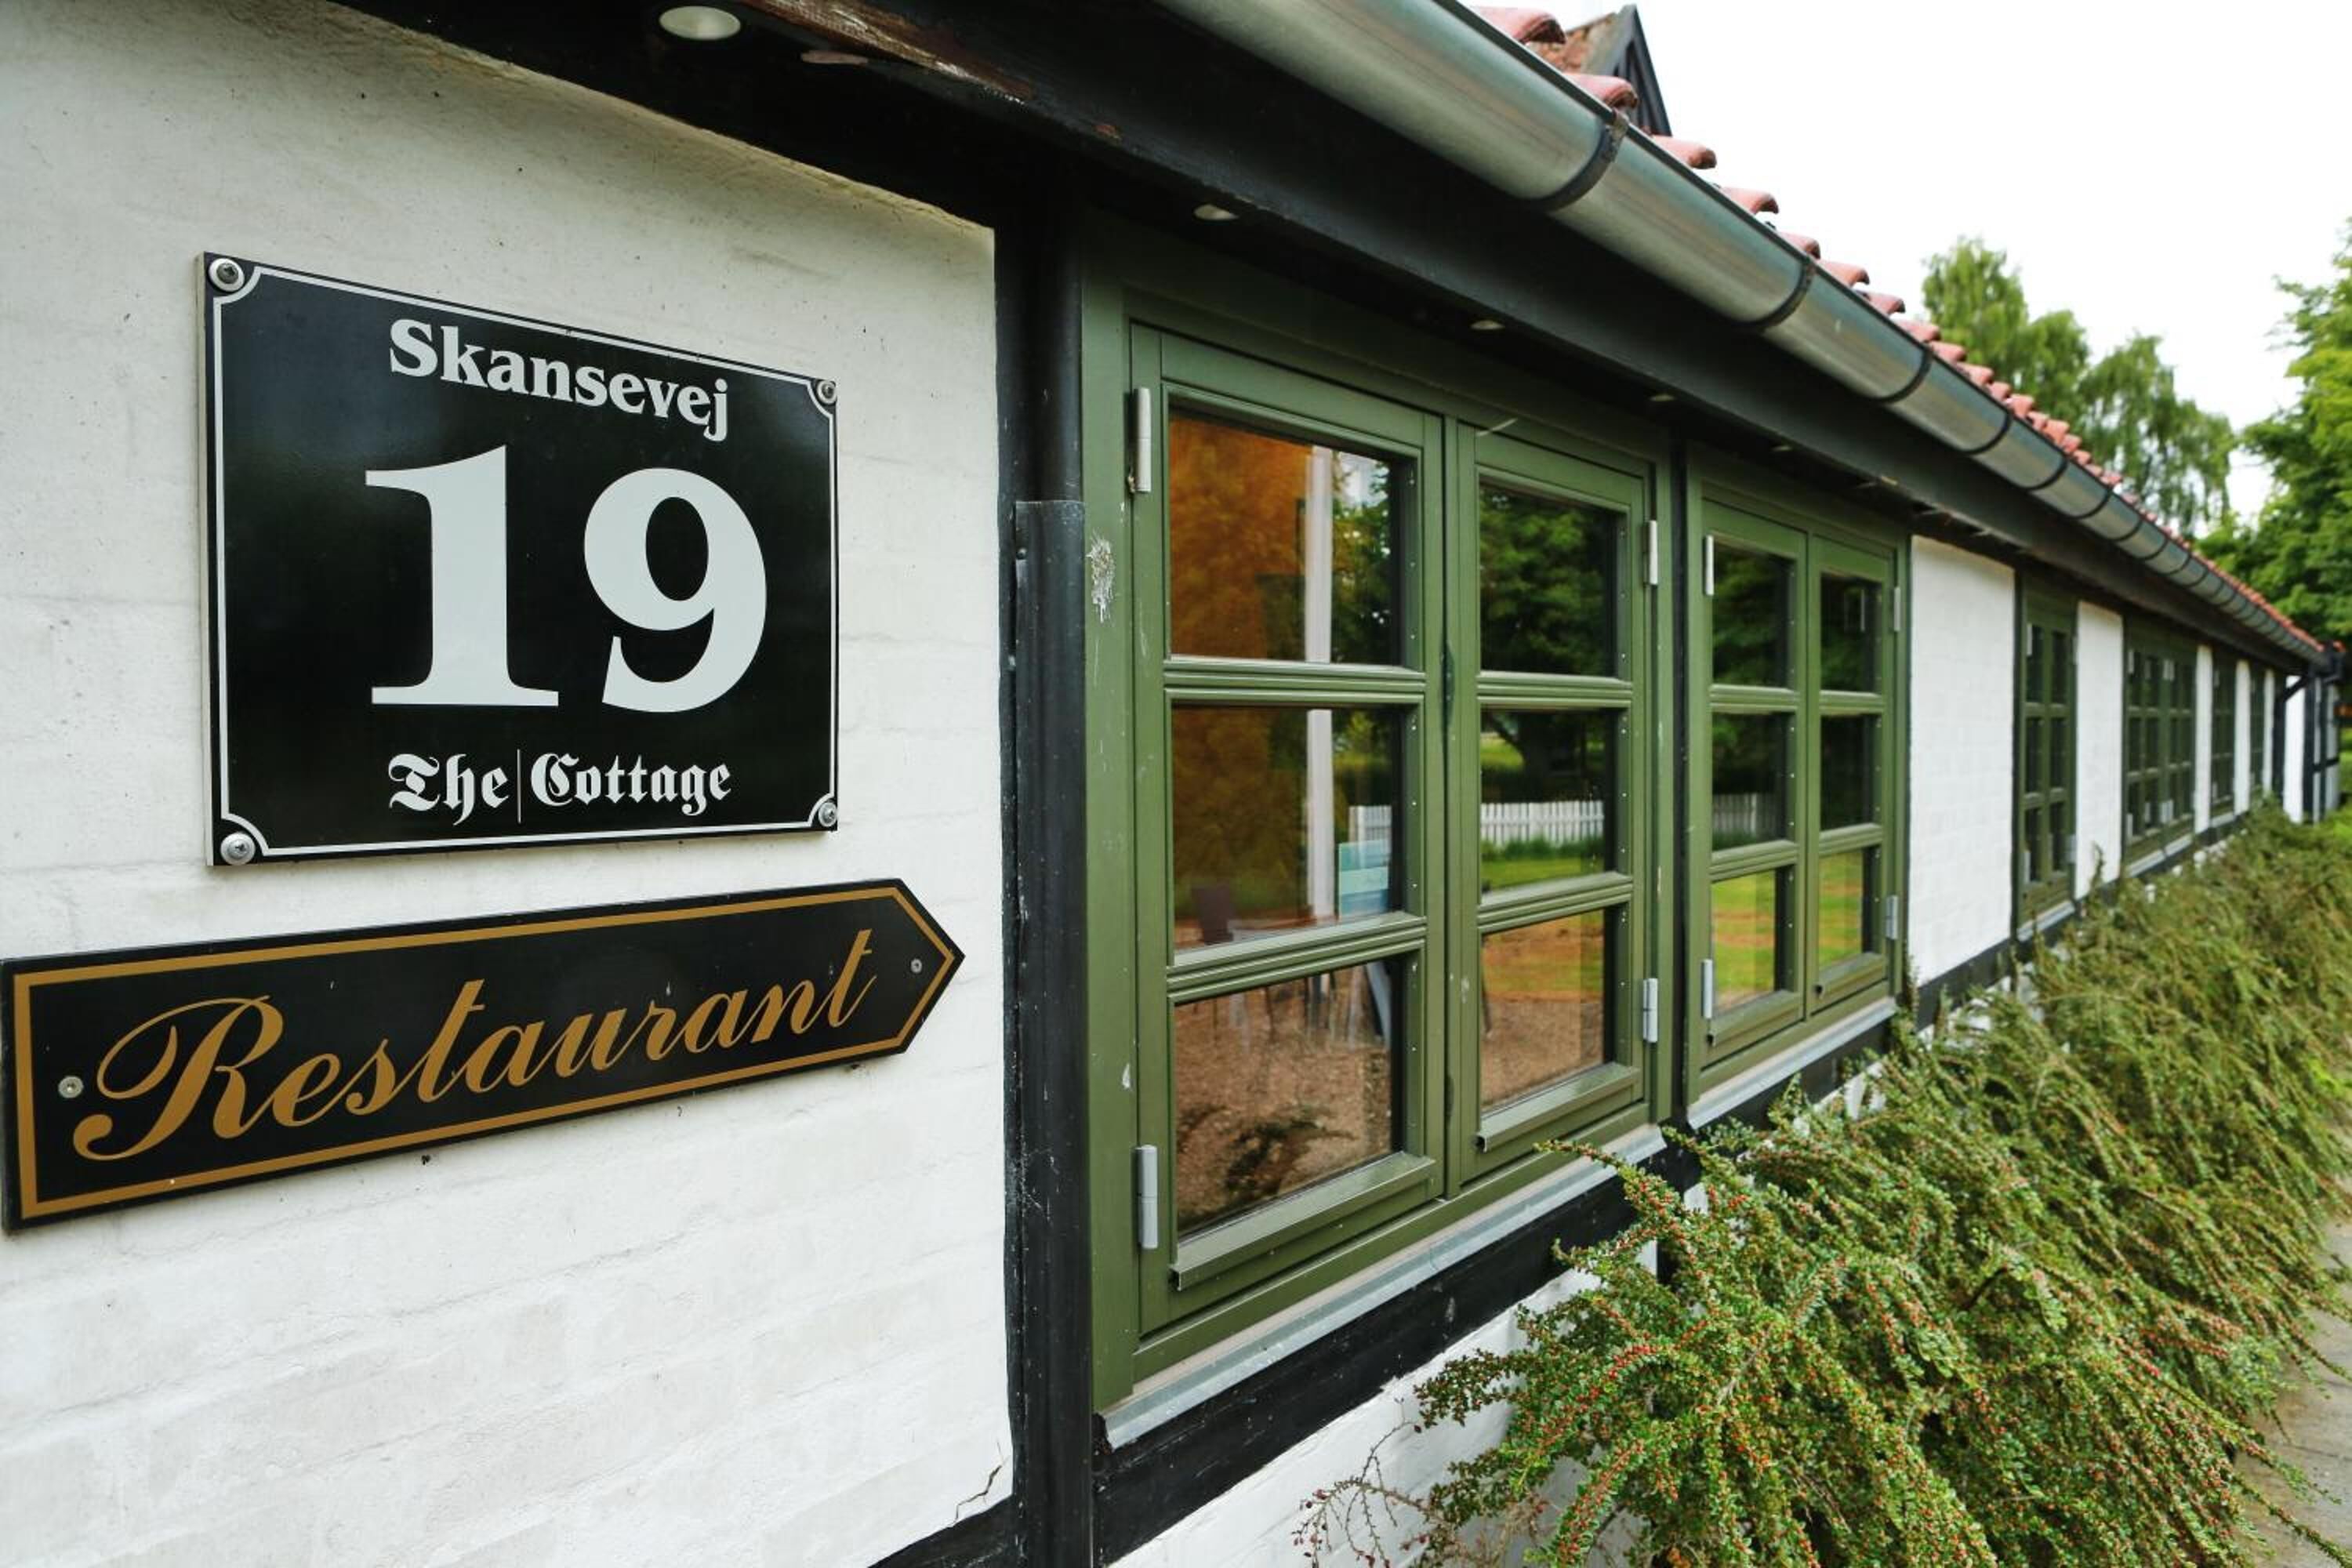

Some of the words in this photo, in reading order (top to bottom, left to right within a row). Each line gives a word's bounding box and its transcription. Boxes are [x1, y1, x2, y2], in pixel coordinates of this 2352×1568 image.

[390, 318, 728, 441] Skansevej
[365, 445, 767, 713] 19
[388, 753, 509, 826] The
[530, 753, 731, 816] Cottage
[73, 929, 877, 1161] Restaurant
